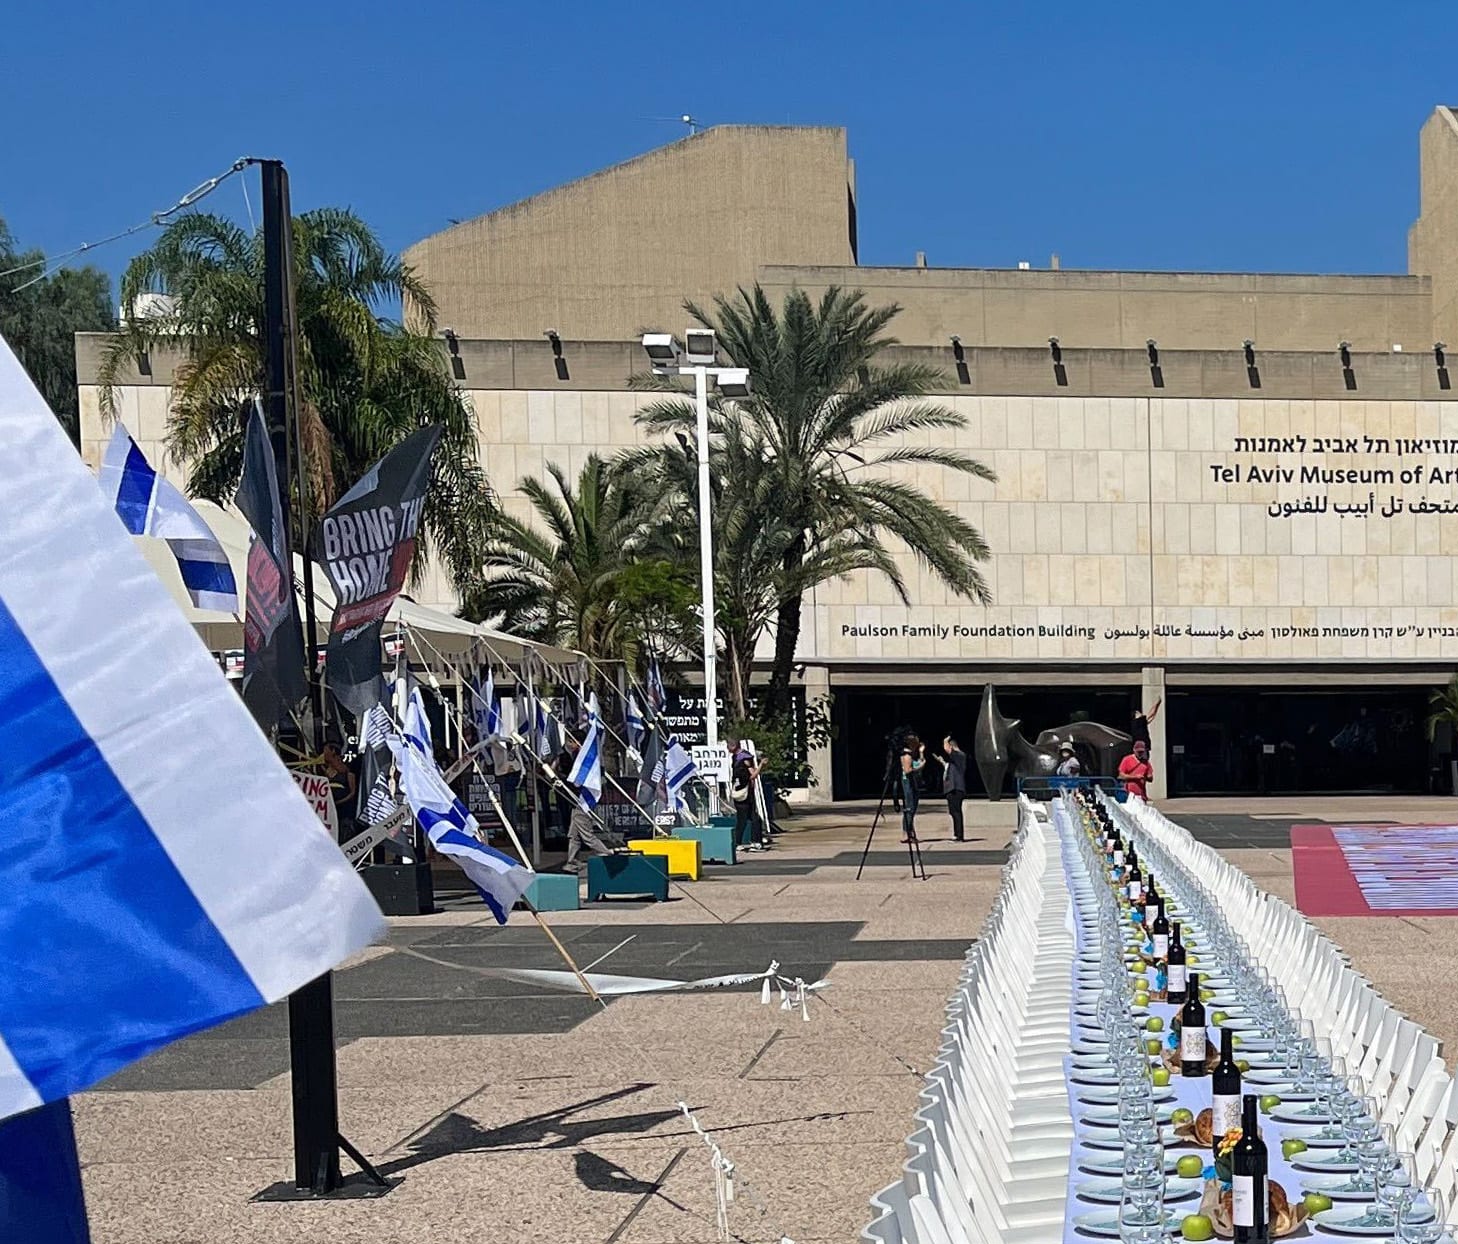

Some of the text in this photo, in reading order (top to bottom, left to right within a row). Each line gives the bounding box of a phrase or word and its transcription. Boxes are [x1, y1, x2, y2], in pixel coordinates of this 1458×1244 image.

[1234, 434, 1307, 453] לאמנות
[1312, 438, 1358, 454] אביב
[1363, 435, 1390, 454] תל
[1210, 463, 1240, 483] Tel
[1246, 464, 1294, 483] Aviv
[1300, 466, 1394, 484] Museum
[1399, 465, 1423, 484] of
[1267, 496, 1328, 518] للفنون
[1333, 492, 1375, 519] أبيب
[1381, 496, 1404, 518] تل
[323, 505, 396, 560] BRING
[329, 548, 393, 605] HOME
[842, 624, 1096, 641] Paulson Family Foundation Building
[1104, 624, 1150, 641] بولسون
[1152, 624, 1182, 638] عائلة
[1184, 624, 1234, 640] مؤسسة
[1271, 625, 1319, 639] פאולסון
[1322, 627, 1369, 637] משפחת
[1372, 627, 1393, 639] קרן
[694, 749, 727, 759] מרחב
[699, 759, 722, 771] מוגן
